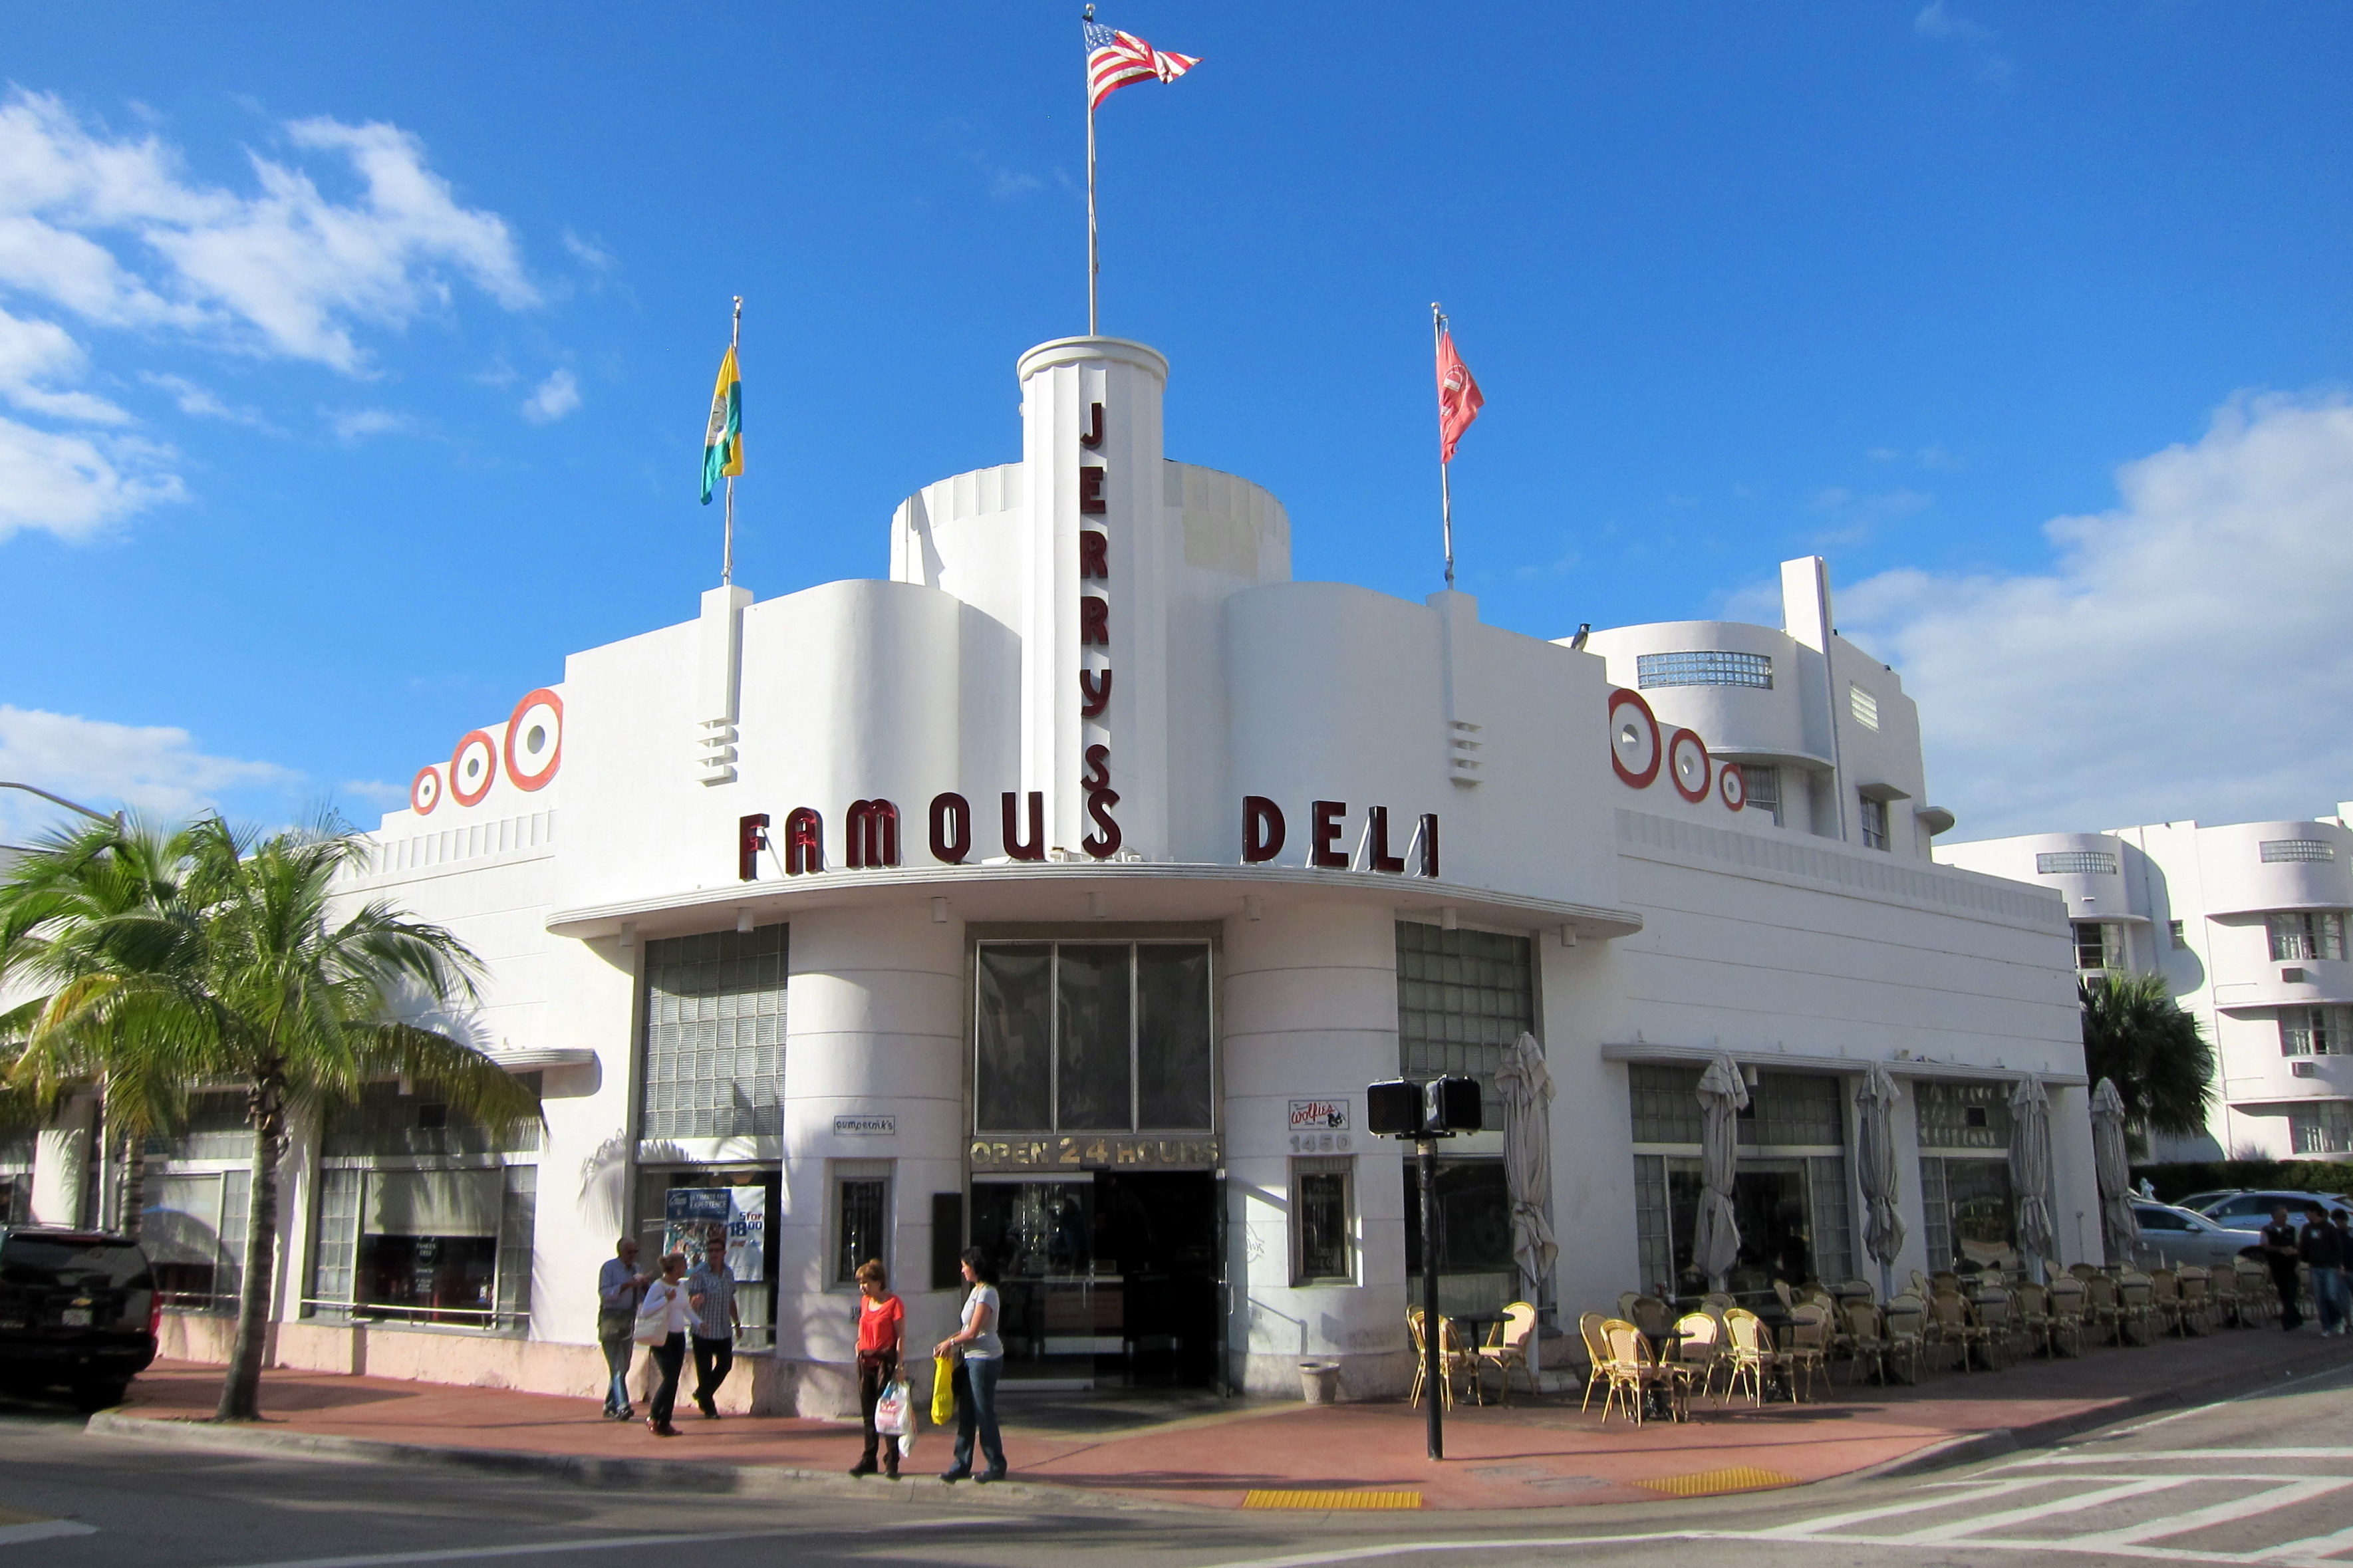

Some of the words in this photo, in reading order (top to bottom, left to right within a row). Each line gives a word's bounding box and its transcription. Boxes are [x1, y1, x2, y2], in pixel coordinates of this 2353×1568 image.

[739, 788, 1122, 880] FAMOUS
[1242, 795, 1440, 878] DELI
[970, 1141, 1049, 1164] OPEN
[1059, 1136, 1109, 1164] 24
[1117, 1140, 1219, 1164] HOURS
[1290, 1133, 1352, 1153] 1450
